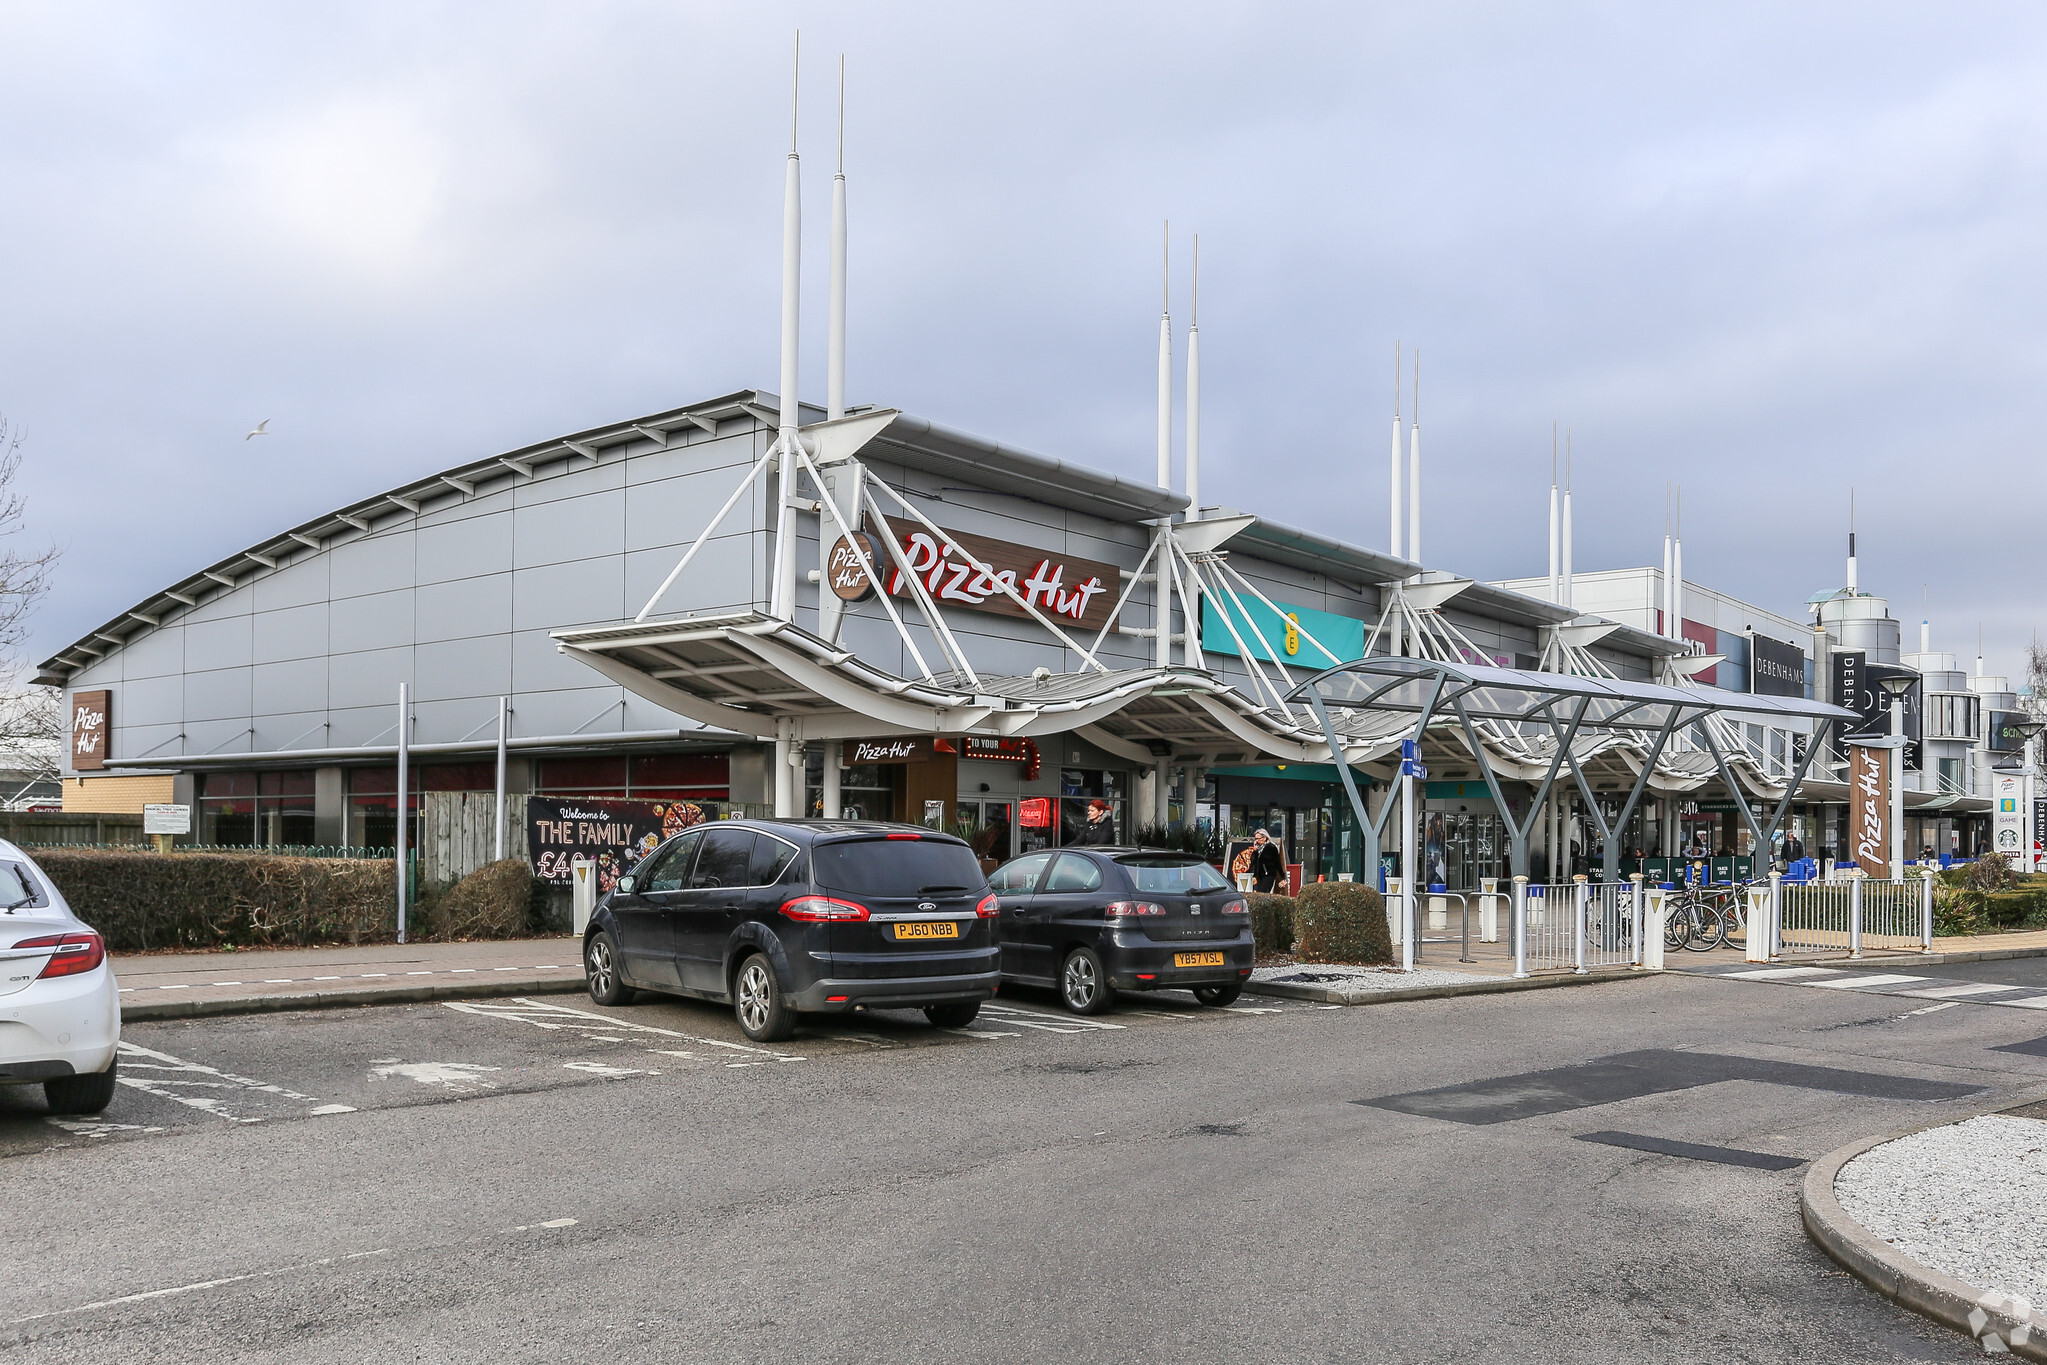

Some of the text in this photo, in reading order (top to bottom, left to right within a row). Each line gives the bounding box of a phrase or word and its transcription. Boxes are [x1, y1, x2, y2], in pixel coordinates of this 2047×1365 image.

[835, 568, 866, 589] Hut
[891, 532, 1107, 619] Pizza Hut
[1757, 657, 1804, 684] DEBENHAMS
[1843, 657, 1855, 757] DEBENAS
[74, 707, 104, 732] Pizza
[77, 732, 100, 755] Hut
[854, 741, 915, 761] Pizza Hut
[971, 738, 980, 748] TO
[981, 738, 999, 749] YOUR
[560, 807, 610, 820] Welcome to
[1857, 747, 1884, 865] Pizza Hut
[536, 821, 573, 844] THE
[899, 923, 953, 936] PJ60 NBB
[1178, 952, 1221, 964] YB57 VSL
